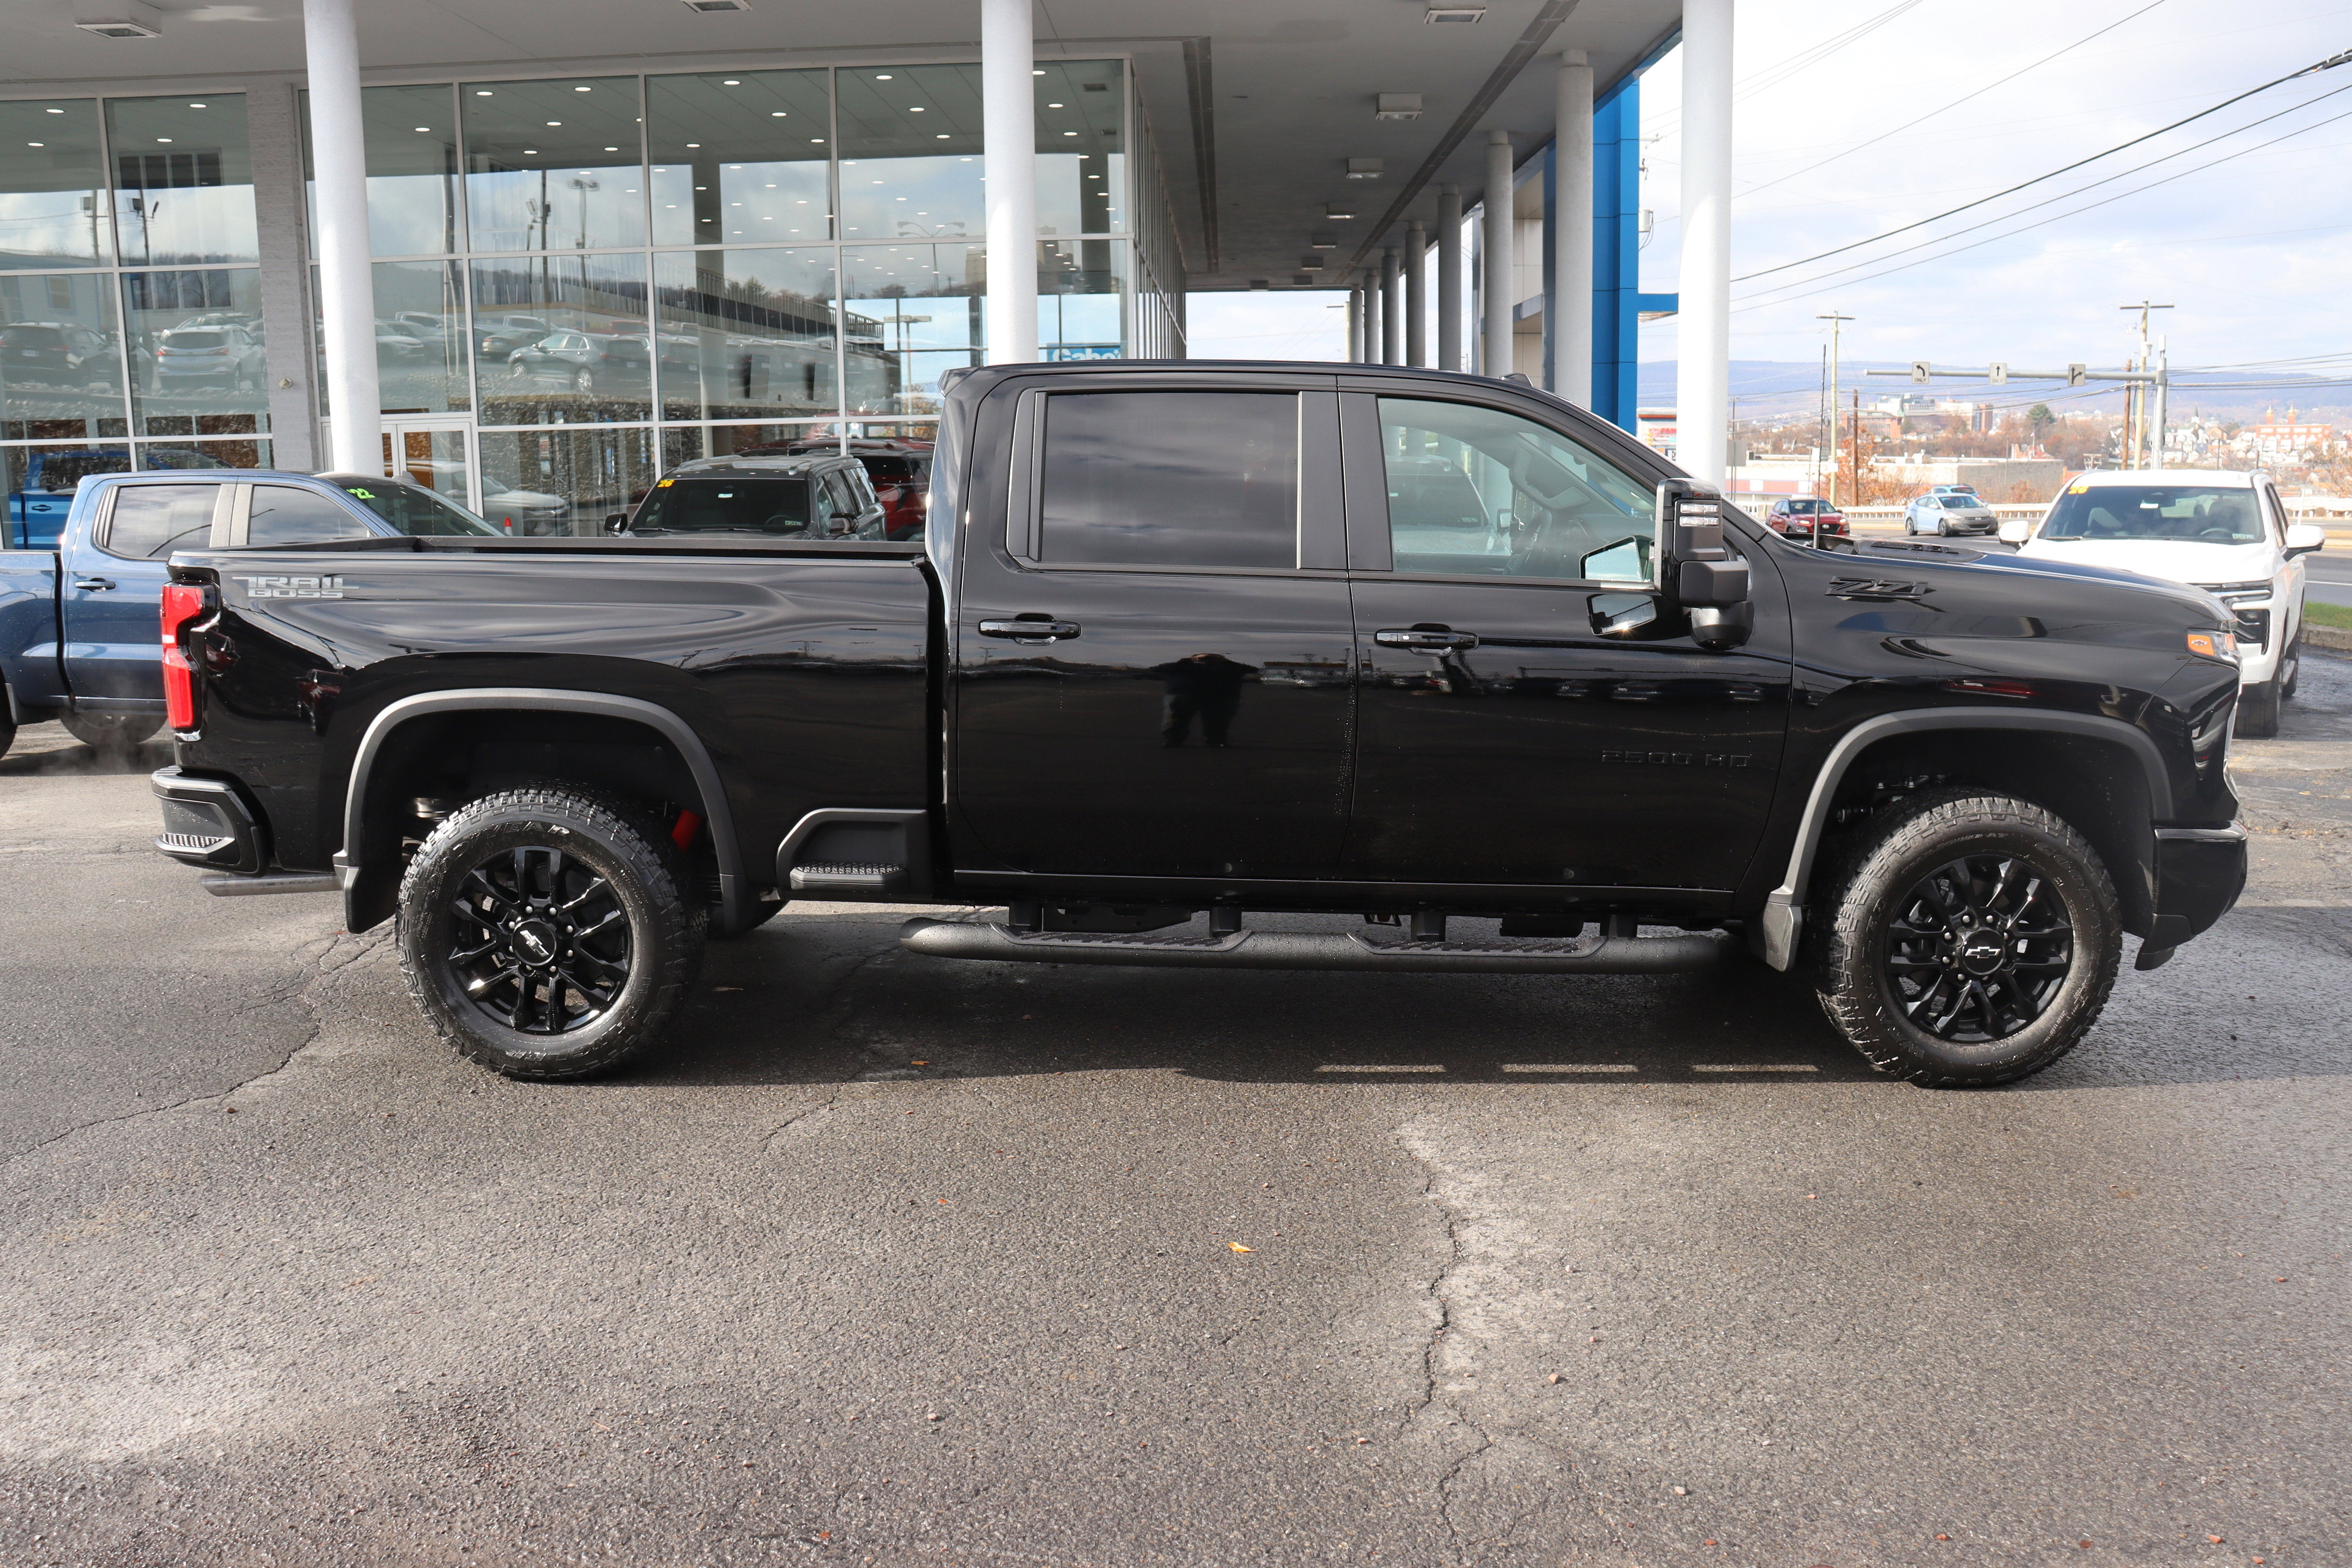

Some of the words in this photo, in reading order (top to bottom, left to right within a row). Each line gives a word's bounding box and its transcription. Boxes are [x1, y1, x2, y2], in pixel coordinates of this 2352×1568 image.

[232, 576, 359, 589] TRAIL
[1824, 576, 1928, 601] Z71
[248, 588, 343, 598] BOSS
[1602, 751, 1693, 764] 2500
[1706, 754, 1751, 767] HD
